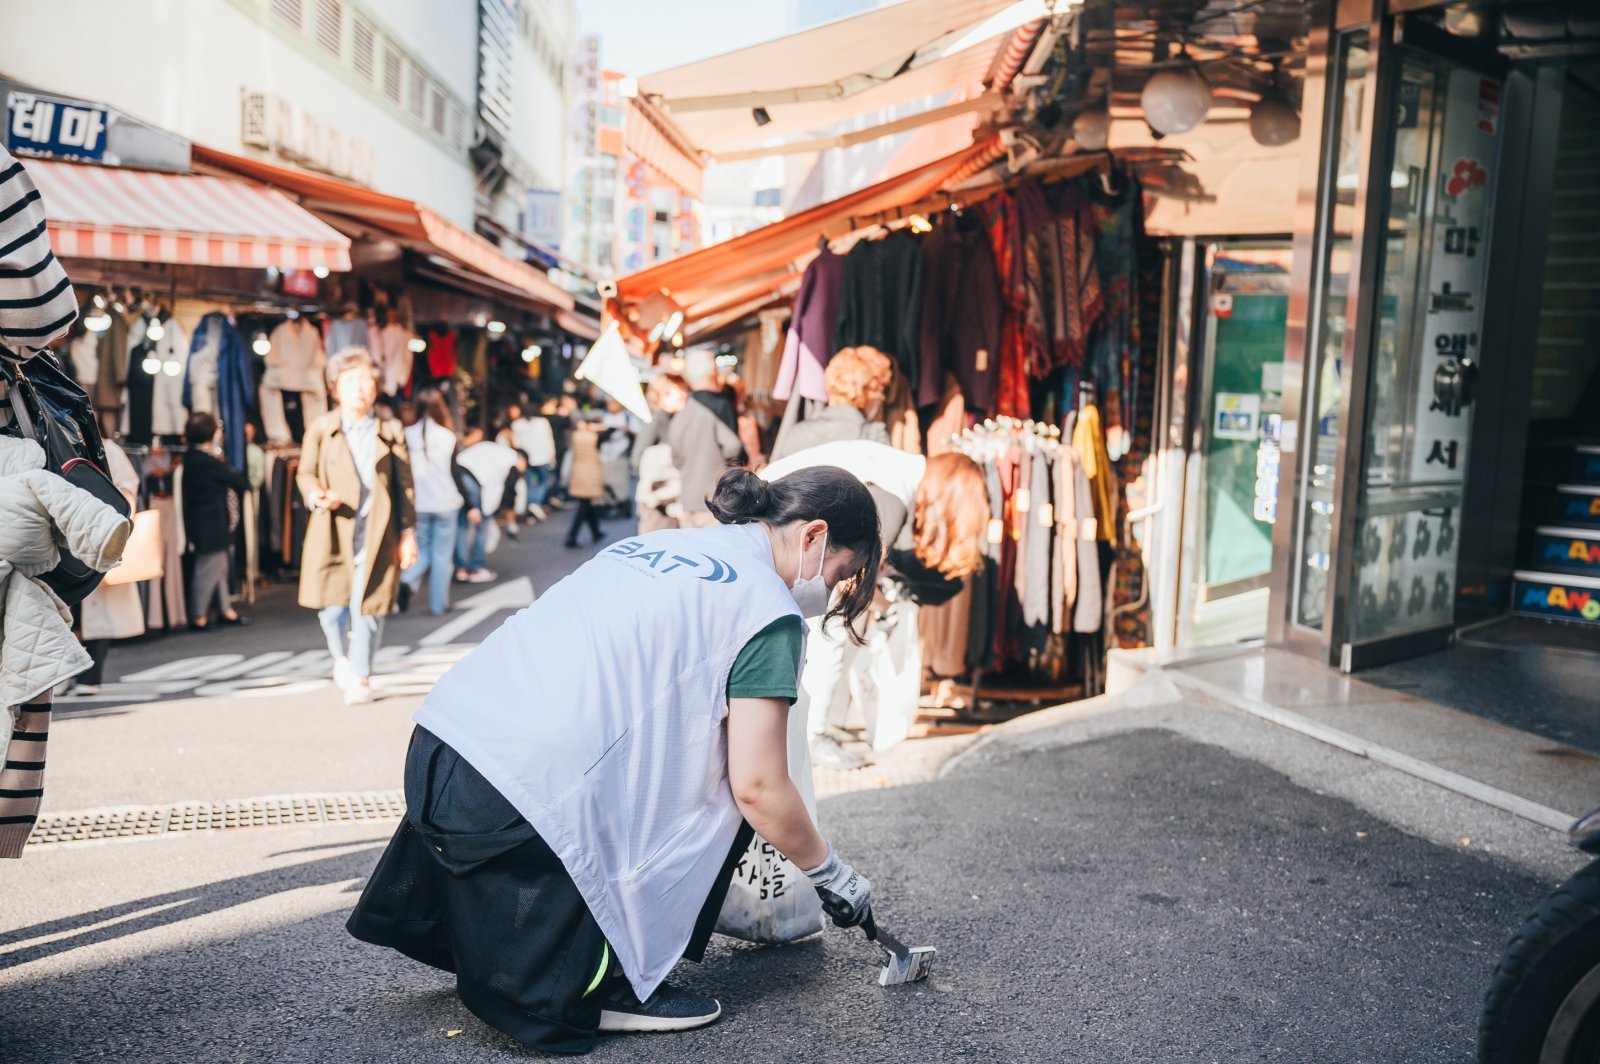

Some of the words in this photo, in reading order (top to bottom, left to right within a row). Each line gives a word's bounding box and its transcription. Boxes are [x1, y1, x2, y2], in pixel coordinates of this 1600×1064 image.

[12, 96, 105, 151] 테마
[606, 540, 700, 574] BAT
[1522, 585, 1600, 621] MANO
